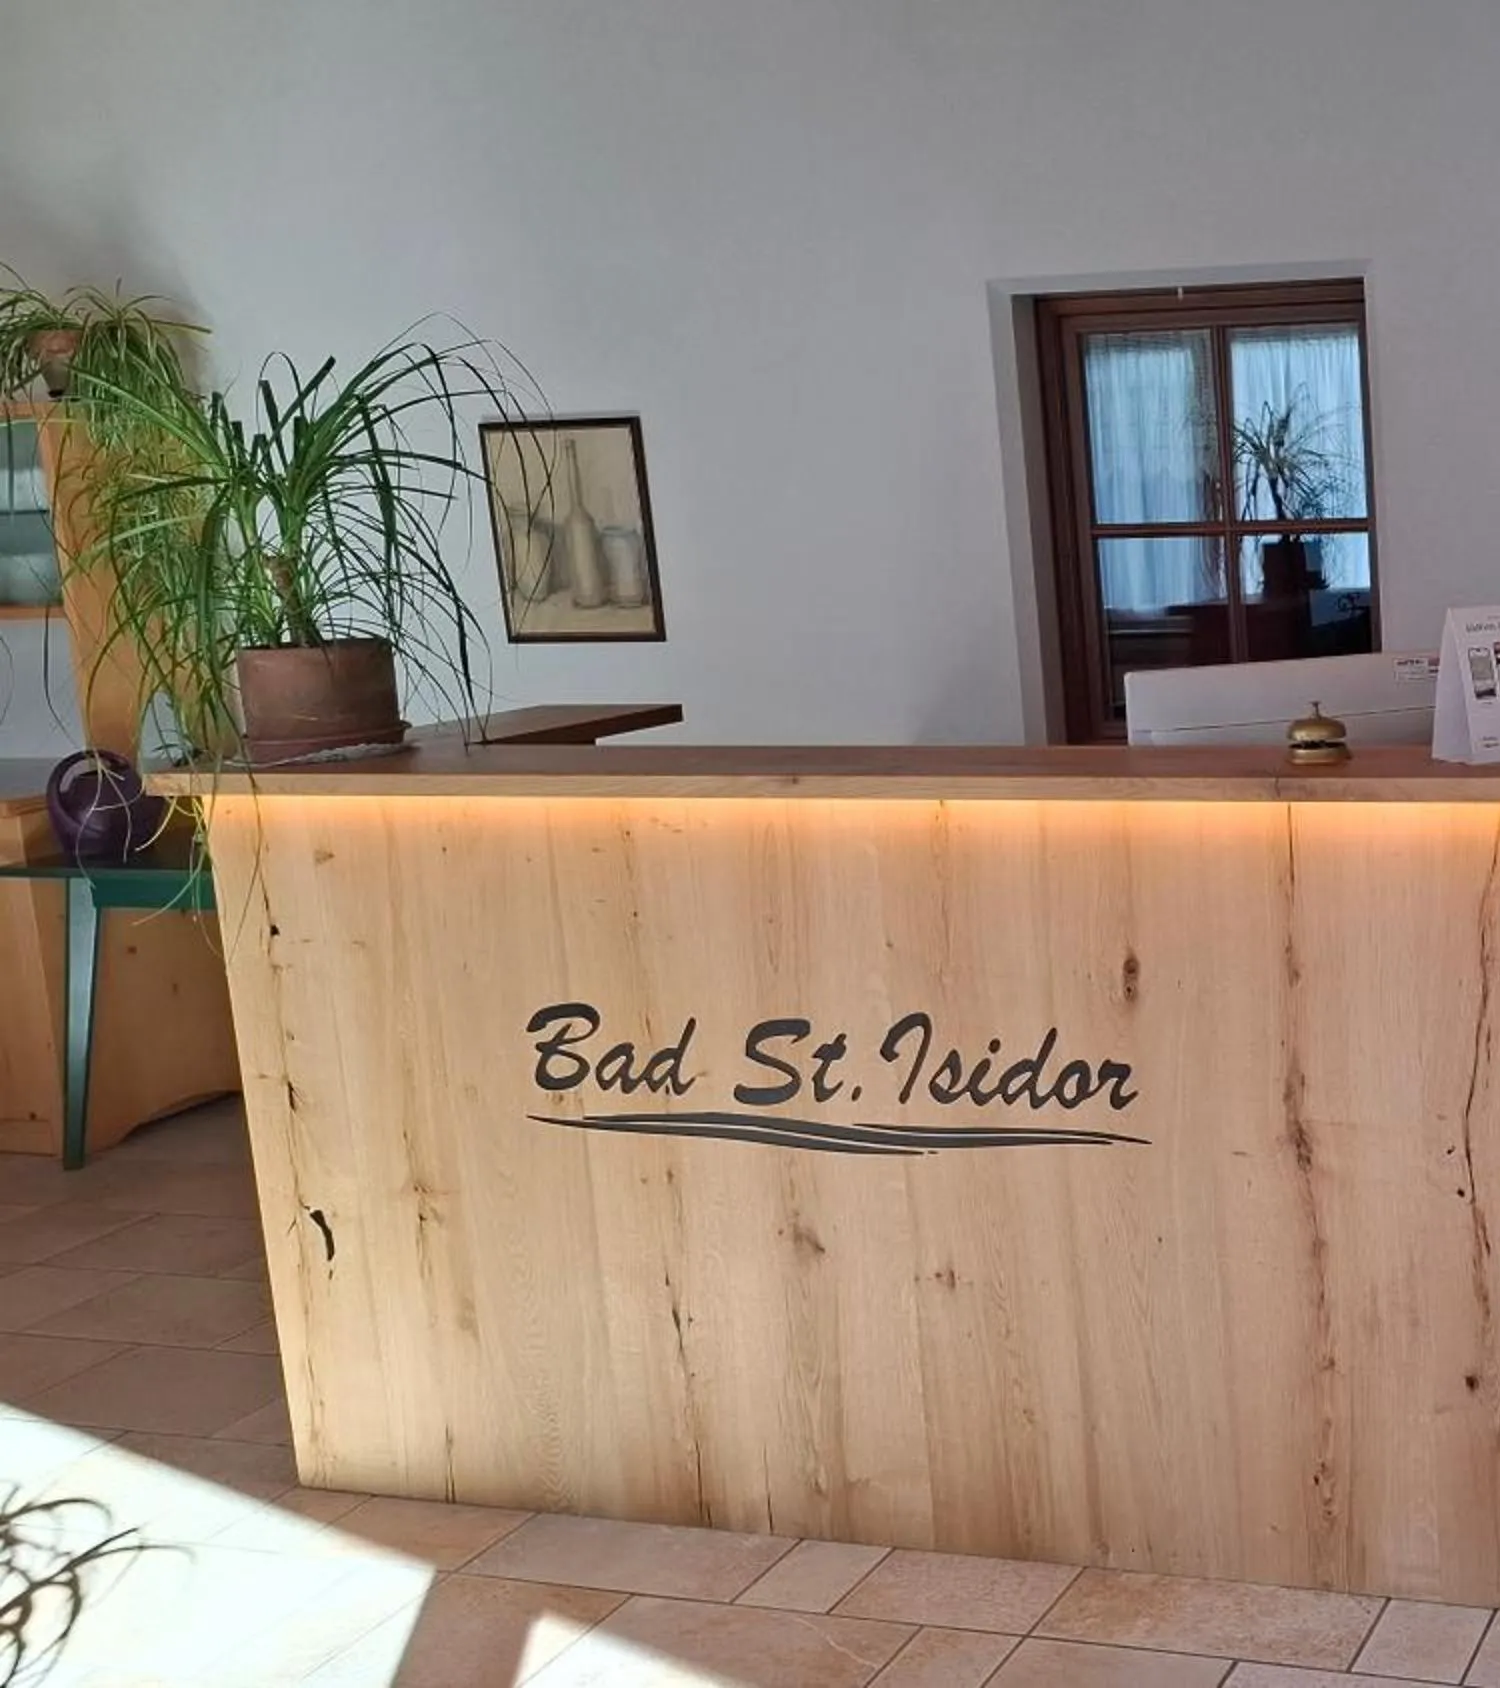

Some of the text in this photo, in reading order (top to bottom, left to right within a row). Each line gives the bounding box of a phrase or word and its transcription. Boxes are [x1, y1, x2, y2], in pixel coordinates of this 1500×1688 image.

[526, 1003, 1138, 1110] Bad St. Isidor
